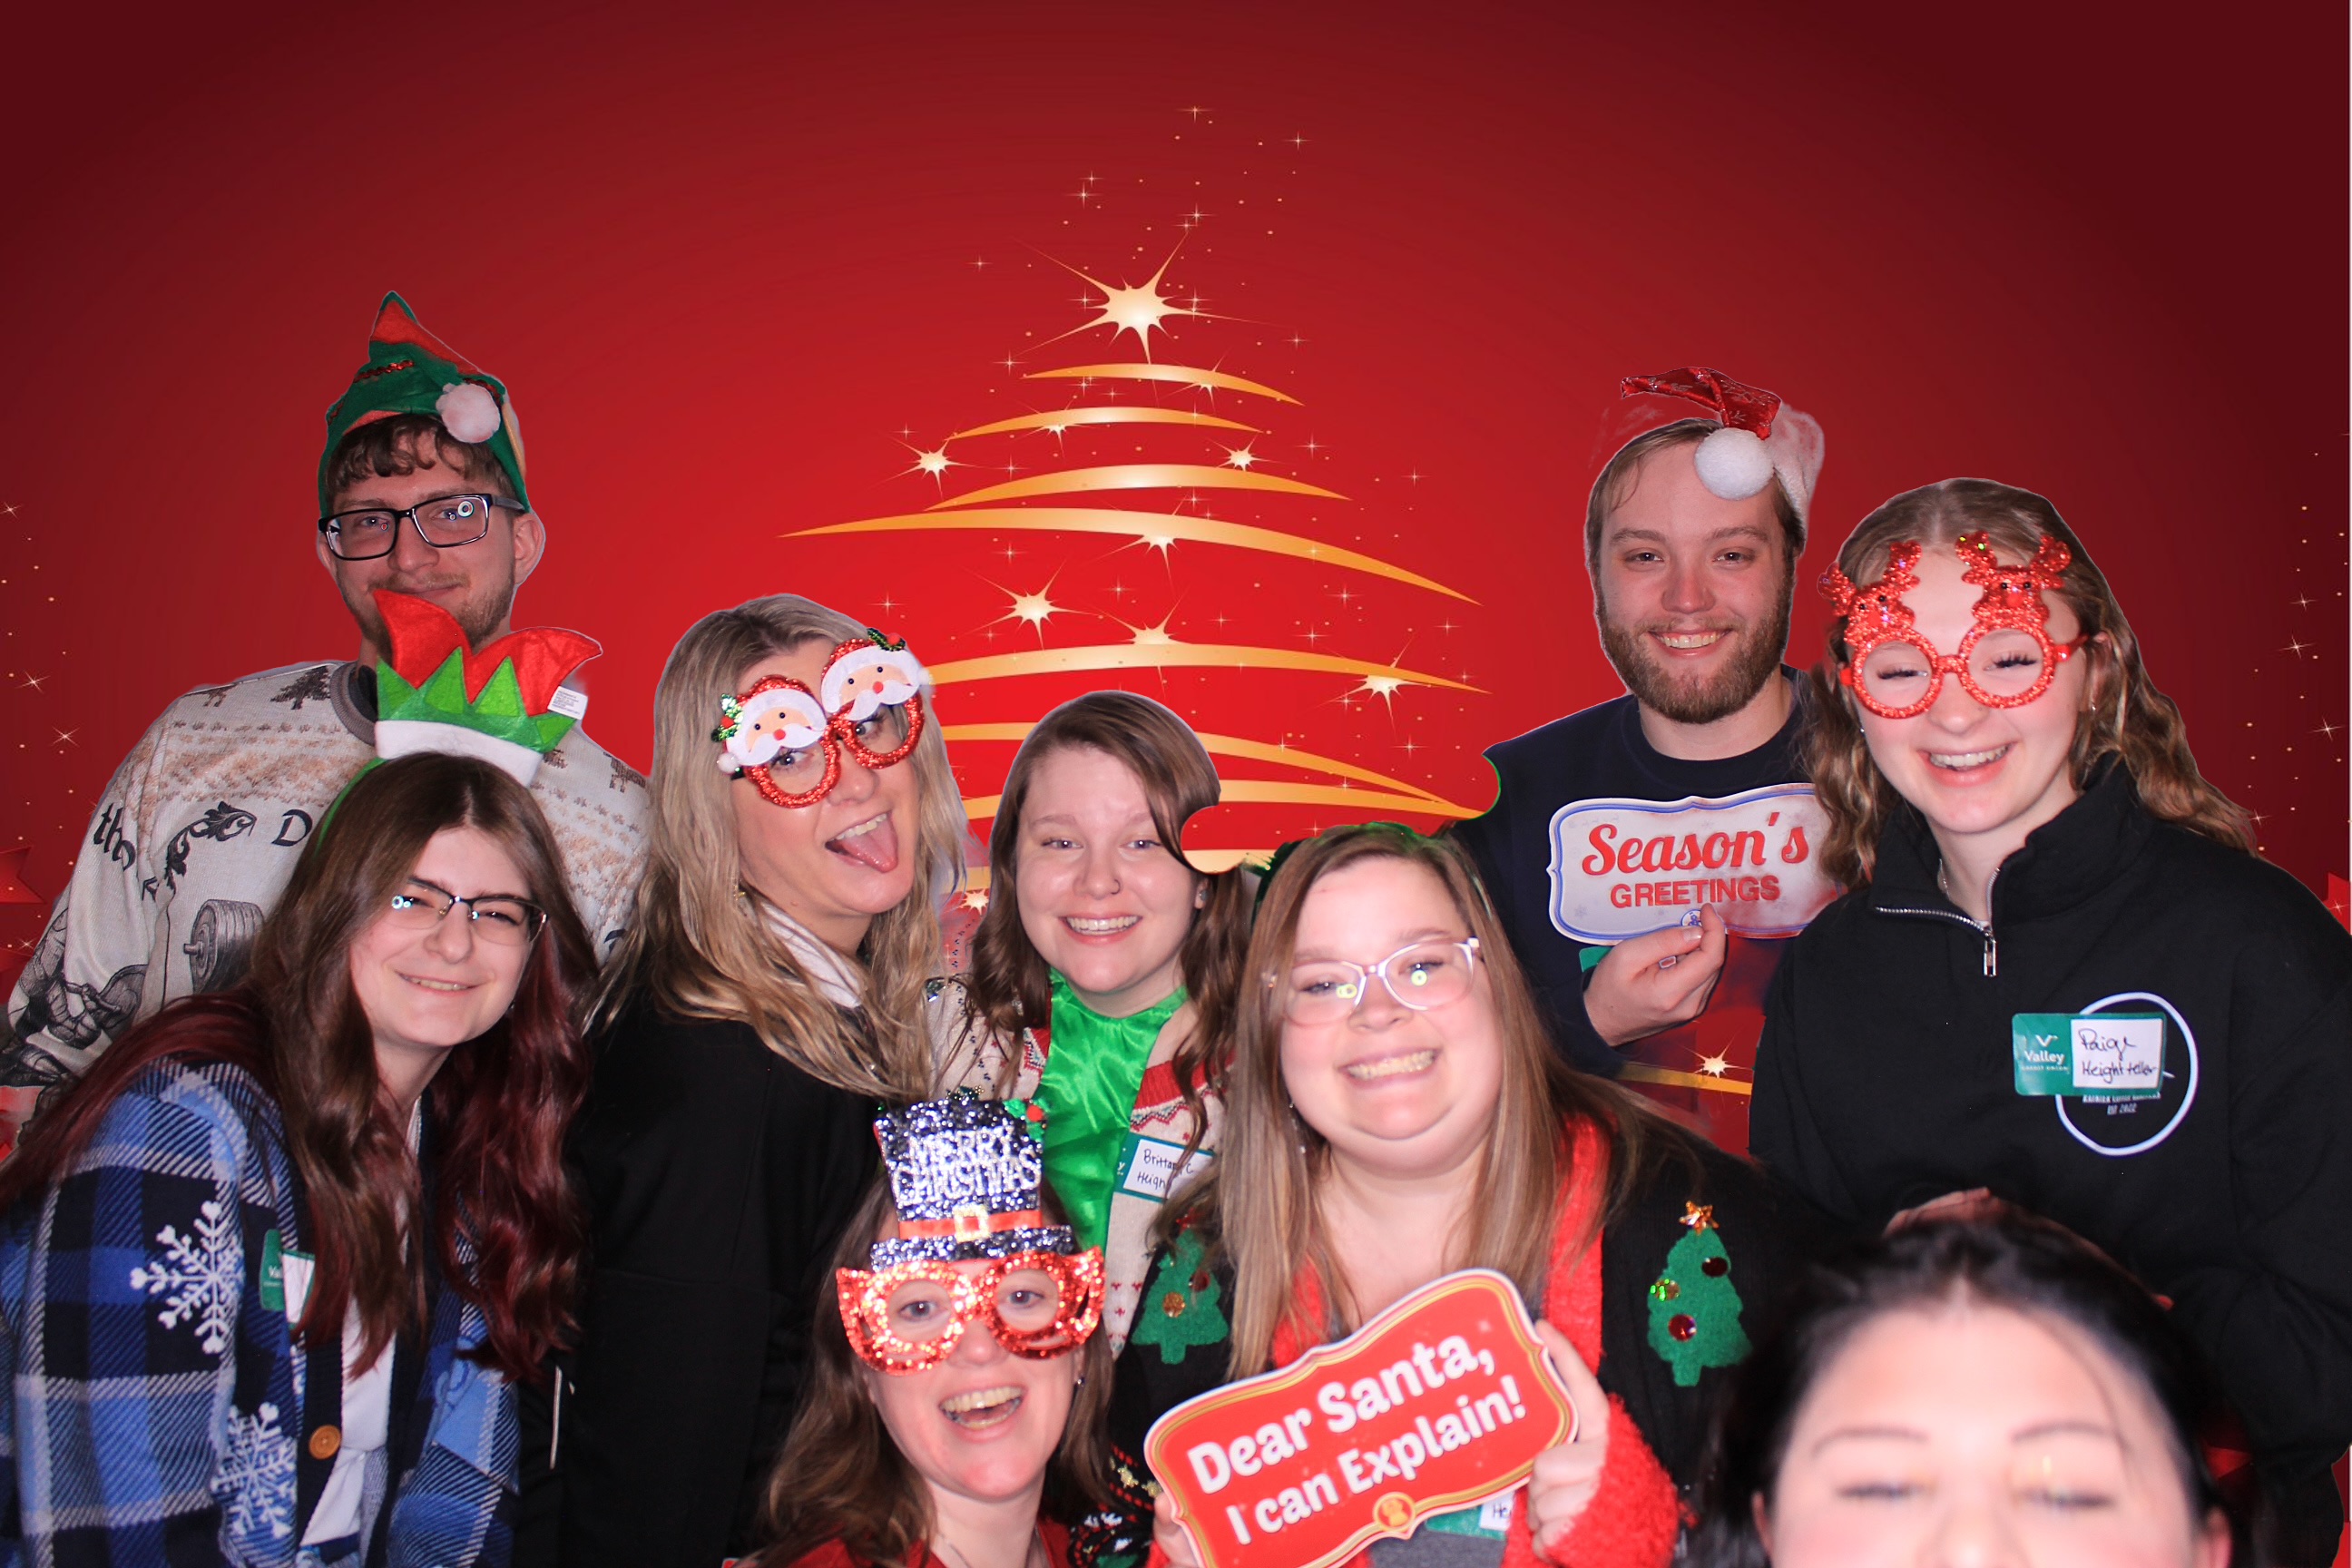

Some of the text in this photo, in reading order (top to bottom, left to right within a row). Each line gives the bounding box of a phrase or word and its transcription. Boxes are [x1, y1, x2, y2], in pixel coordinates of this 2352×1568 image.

[1582, 812, 1809, 876] Season's
[1610, 875, 1781, 908] GREETINGS
[2024, 1050, 2065, 1065] Valley
[2078, 1028, 2137, 1062] Paige
[1187, 1335, 1496, 1494] Dear Santa,
[1226, 1375, 1527, 1545] I can Explain!
